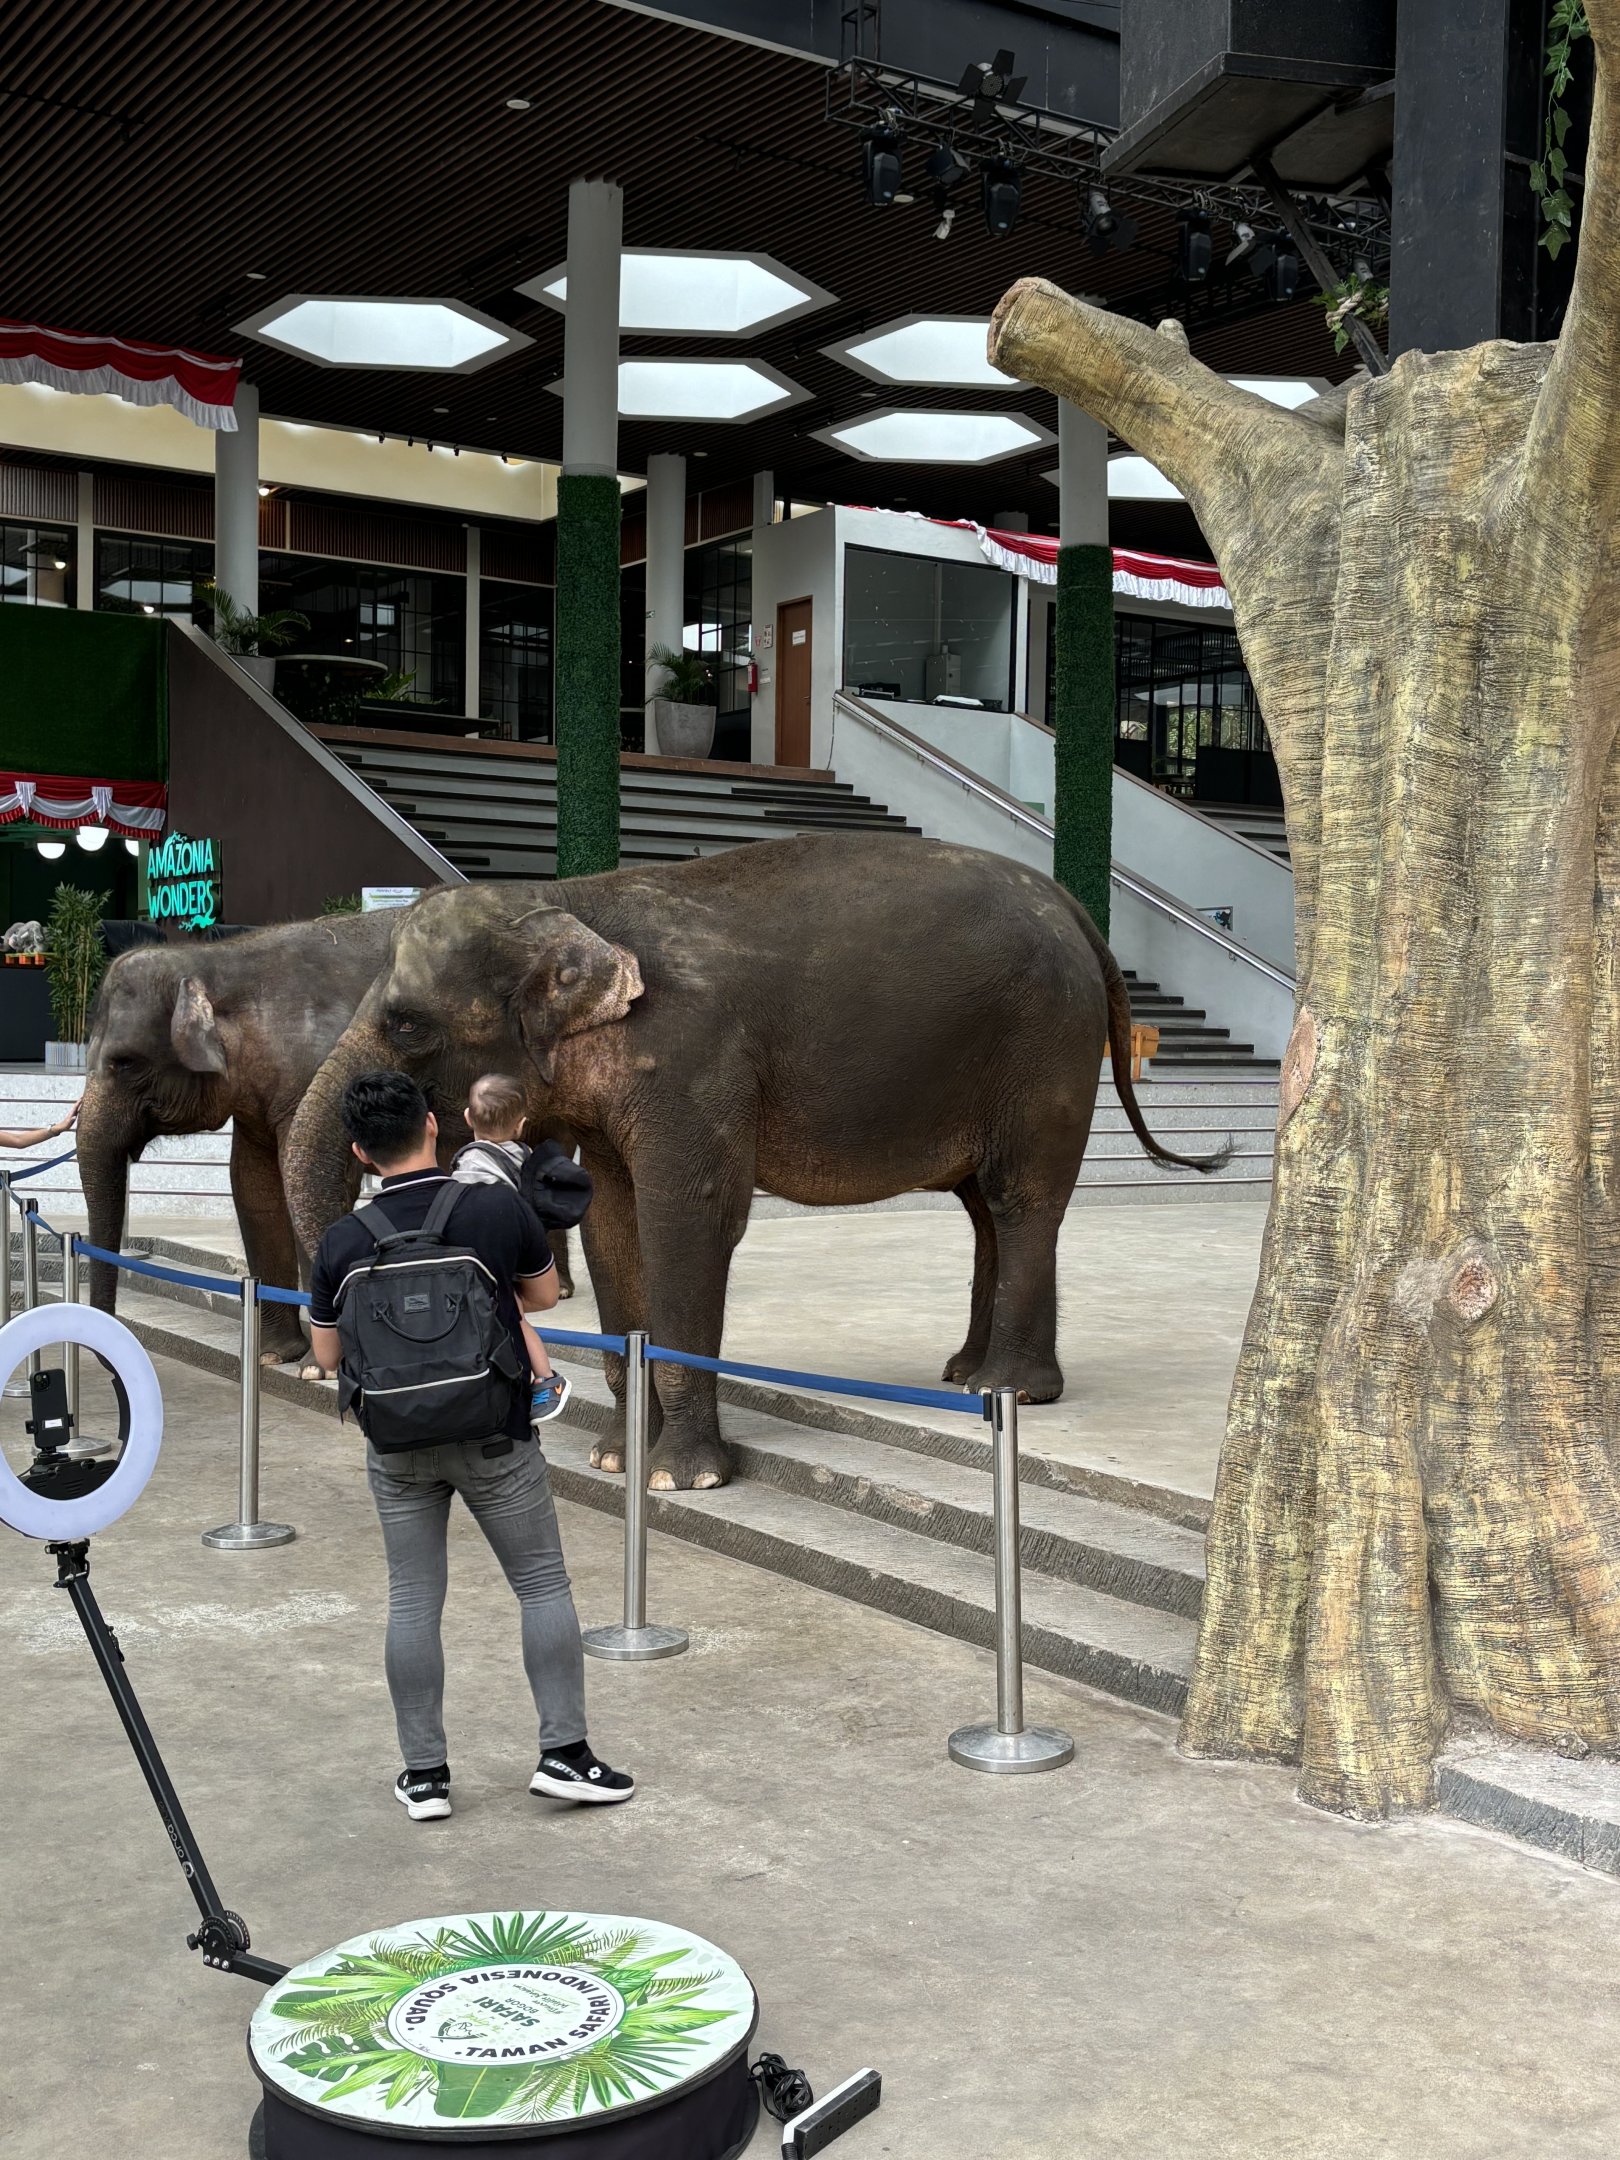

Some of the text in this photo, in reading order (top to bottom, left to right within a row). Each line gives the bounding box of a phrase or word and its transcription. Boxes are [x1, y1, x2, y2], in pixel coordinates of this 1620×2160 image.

[147, 838, 214, 879] AMAZONIA
[147, 880, 214, 919] WONDERS
[549, 1760, 583, 1780] LOTTO
[405, 1784, 428, 1795] OTTO
[459, 1970, 599, 1994] INDONESIA
[405, 1983, 458, 2025] SQUAD
[472, 1996, 540, 2027] SAFARI
[504, 1997, 540, 2014] BOGOR
[568, 1995, 611, 2039] SAFARI
[465, 2037, 568, 2058] TAMAN
